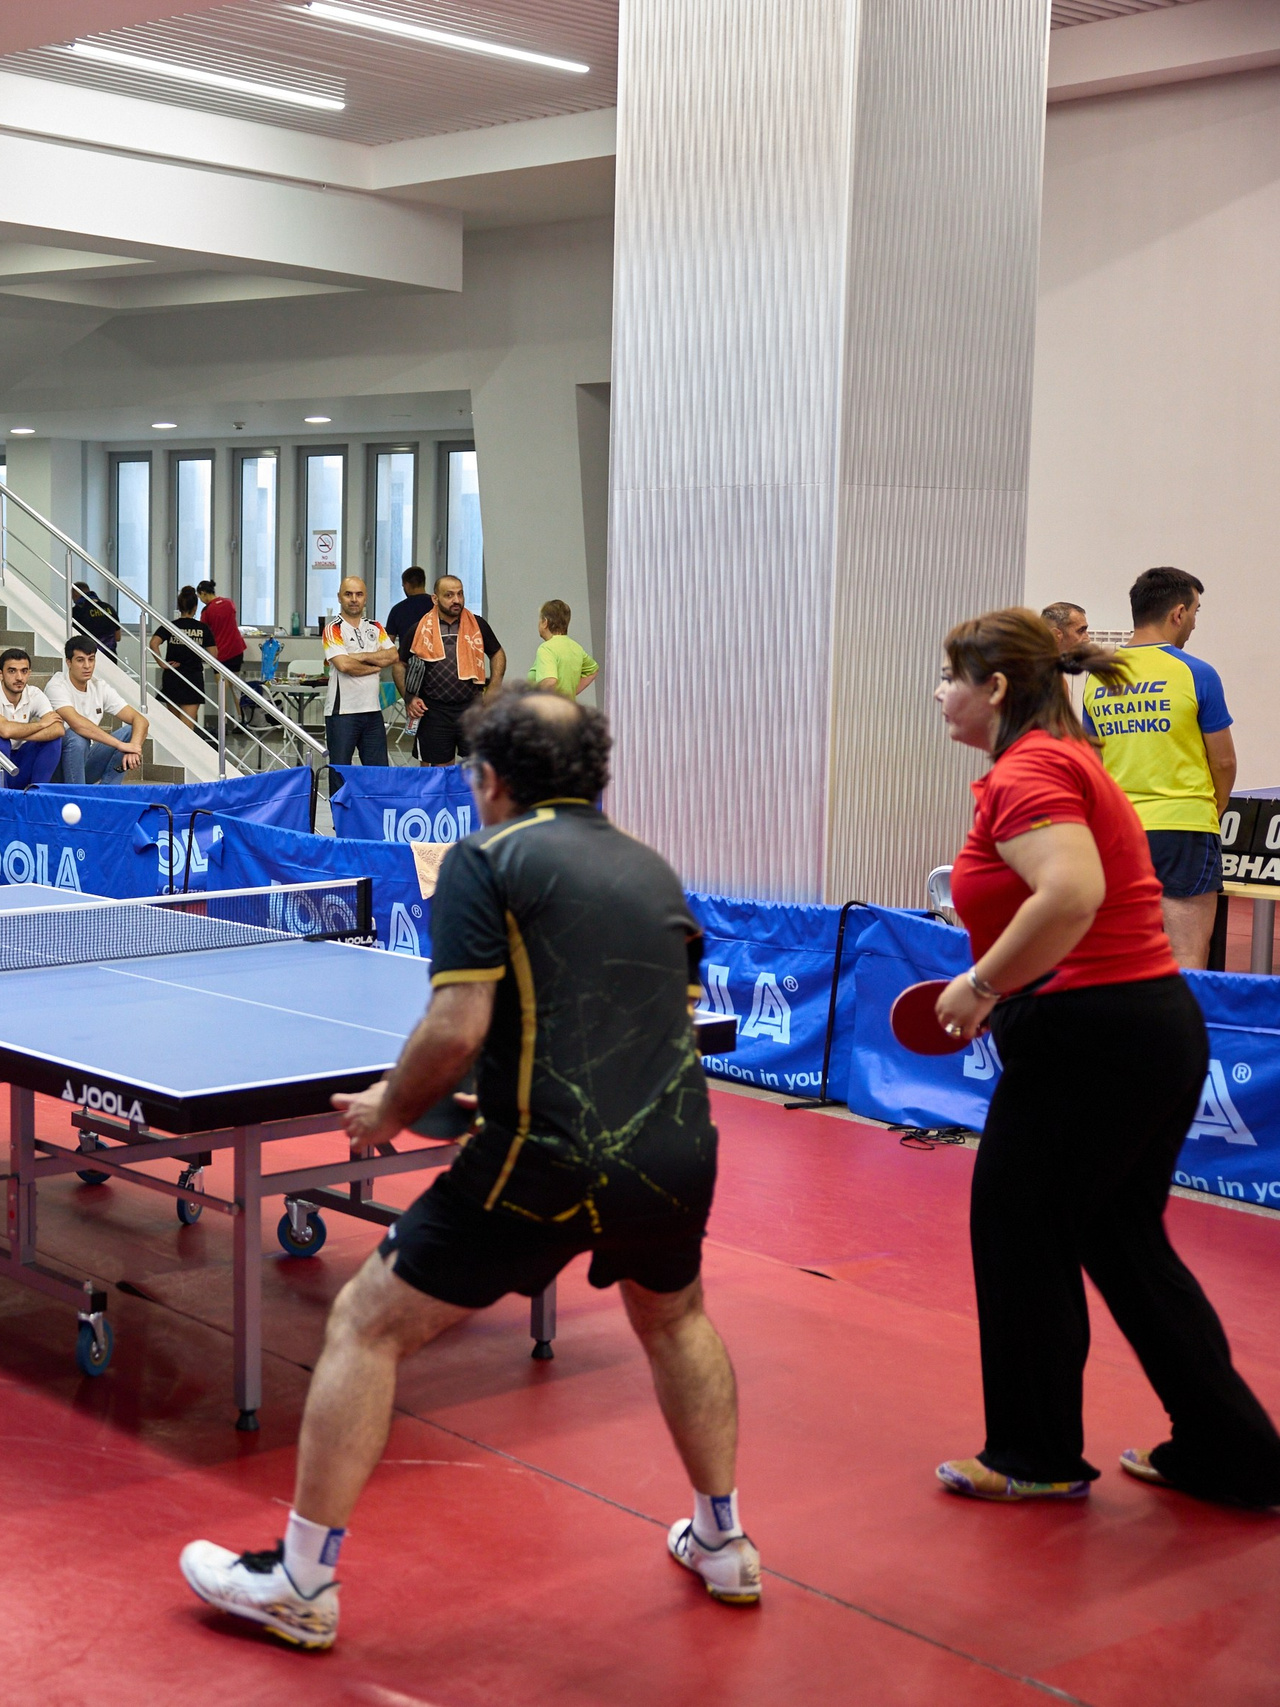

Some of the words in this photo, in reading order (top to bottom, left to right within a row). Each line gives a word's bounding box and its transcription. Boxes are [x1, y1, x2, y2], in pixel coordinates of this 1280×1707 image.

[1092, 699, 1171, 717] UKRAINE
[382, 804, 471, 843] JOOL
[1221, 853, 1280, 881] BHA
[759, 1068, 780, 1087] in
[783, 1071, 830, 1091] you
[77, 1083, 146, 1125] JOOLA
[1217, 1175, 1245, 1198] in
